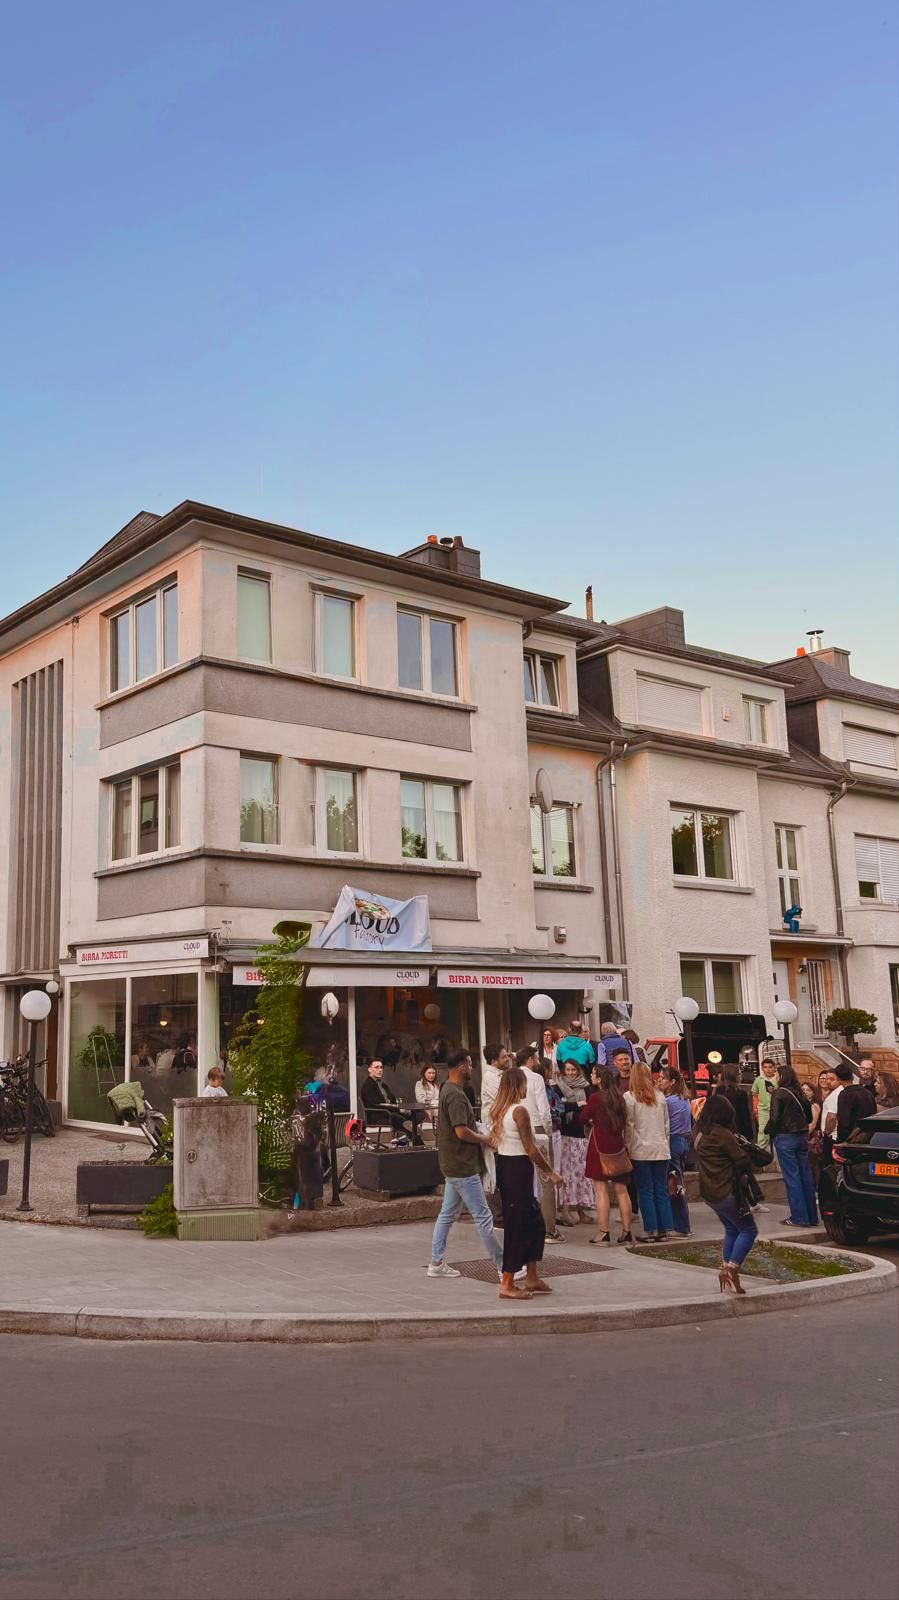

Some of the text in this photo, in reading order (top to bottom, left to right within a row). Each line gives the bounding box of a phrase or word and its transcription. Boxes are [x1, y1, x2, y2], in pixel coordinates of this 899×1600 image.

[345, 910, 400, 934] LOUD
[183, 942, 200, 950] CLOUD
[81, 950, 128, 962] BIRRA MORETTI
[396, 971, 420, 979] CLOUD
[448, 975, 524, 985] BIRRA MORETTI
[880, 1165, 891, 1174] GR
